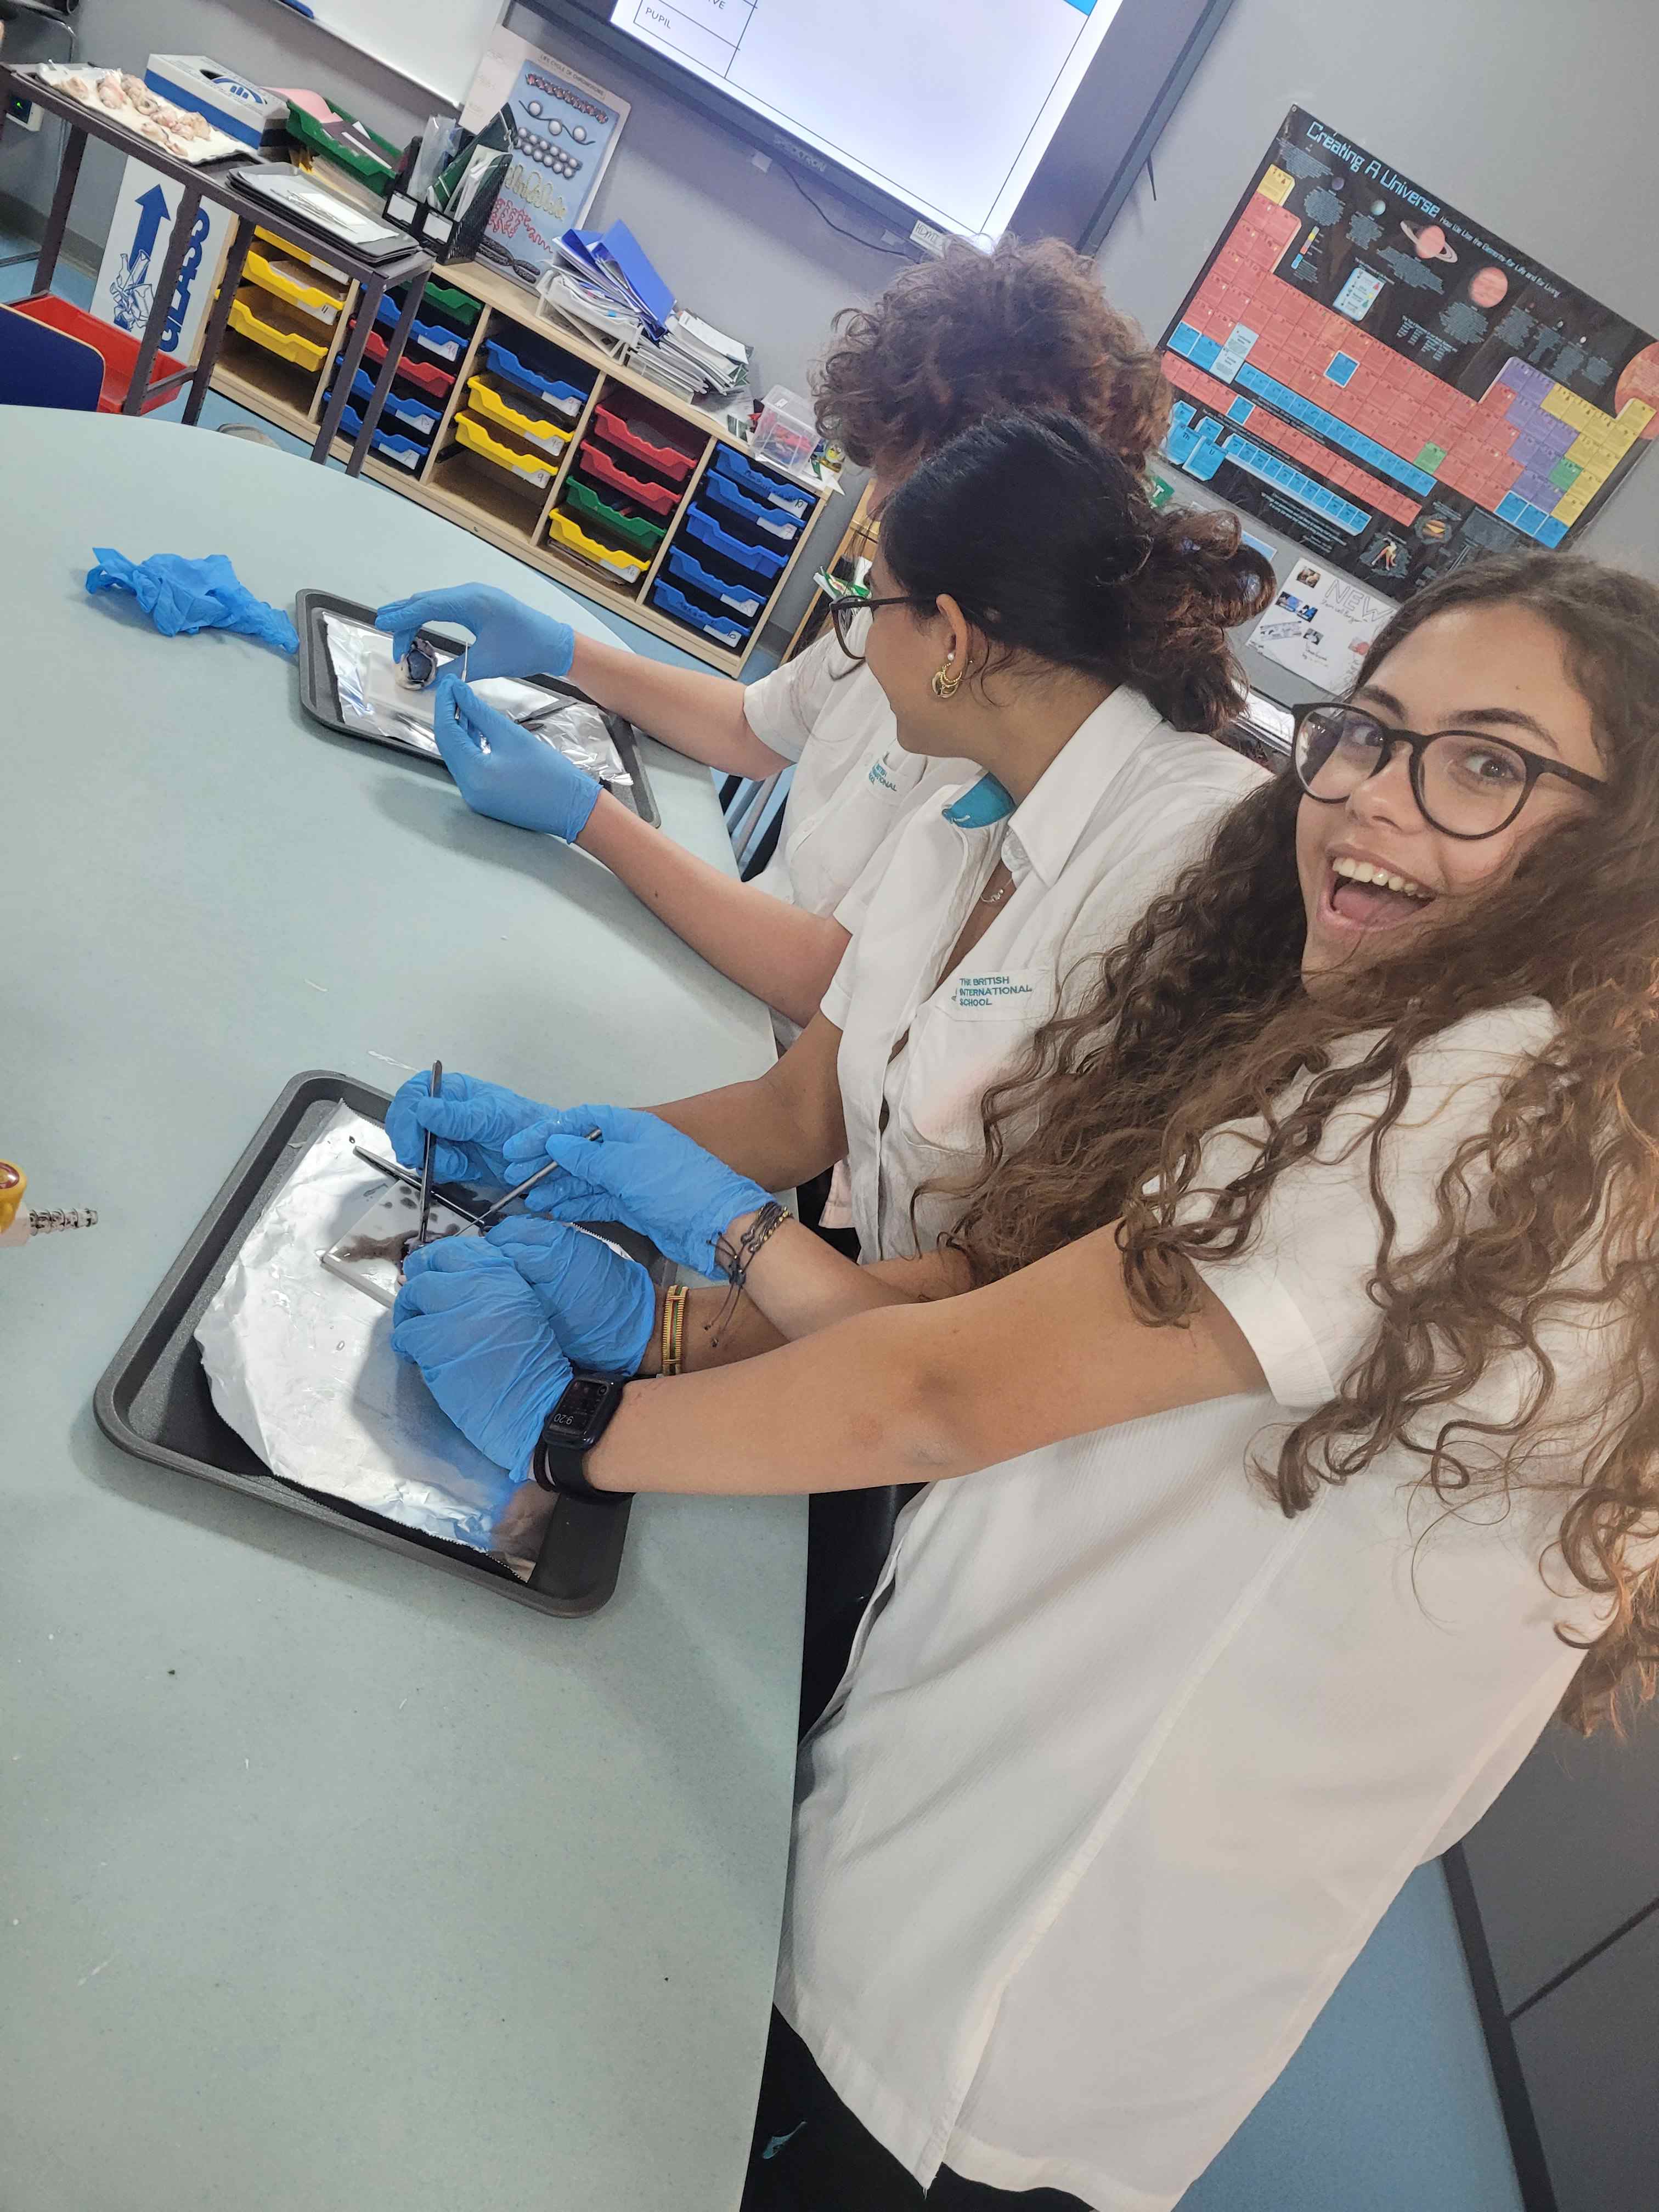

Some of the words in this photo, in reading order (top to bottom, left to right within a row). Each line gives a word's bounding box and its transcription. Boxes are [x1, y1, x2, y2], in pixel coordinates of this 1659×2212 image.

[645, 7, 671, 29] PUPIL
[550, 60, 566, 72] CYCLE
[1306, 121, 1365, 173] Creating
[1364, 160, 1381, 179] A
[1380, 169, 1441, 218] Universe
[915, 223, 940, 244] HDMI
[1461, 229, 1474, 241] Use
[1472, 236, 1483, 247] the
[1325, 579, 1394, 622] NEW
[960, 978, 972, 986] THE
[973, 977, 1010, 986] BRITISH
[960, 985, 1032, 996] INTERNATIONAL
[960, 998, 992, 1007] SCHOOL
[554, 1413, 574, 1425] 9:20
